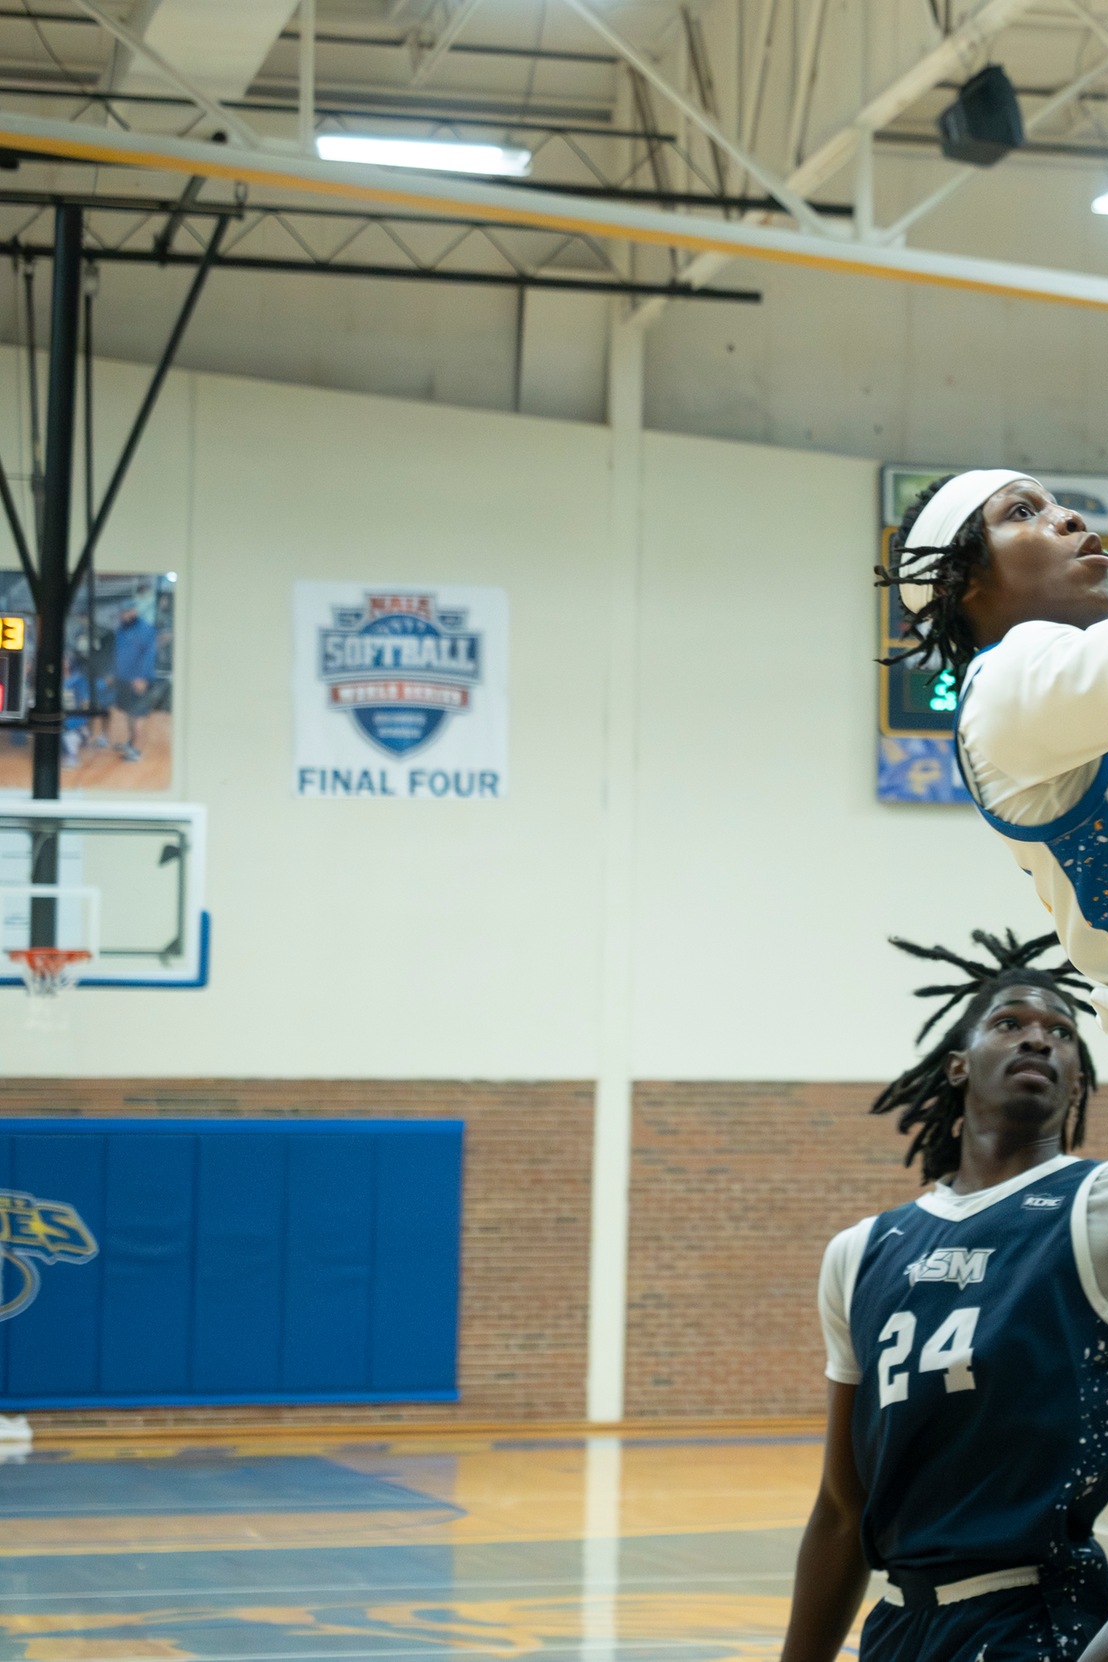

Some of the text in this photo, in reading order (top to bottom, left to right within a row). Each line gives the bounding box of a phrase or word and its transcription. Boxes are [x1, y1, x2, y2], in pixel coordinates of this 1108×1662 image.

[0, 616, 25, 651] 3
[324, 634, 480, 672] SOFTBALL
[298, 767, 500, 798] FINAL FOUR
[877, 1306, 981, 1410] 24
